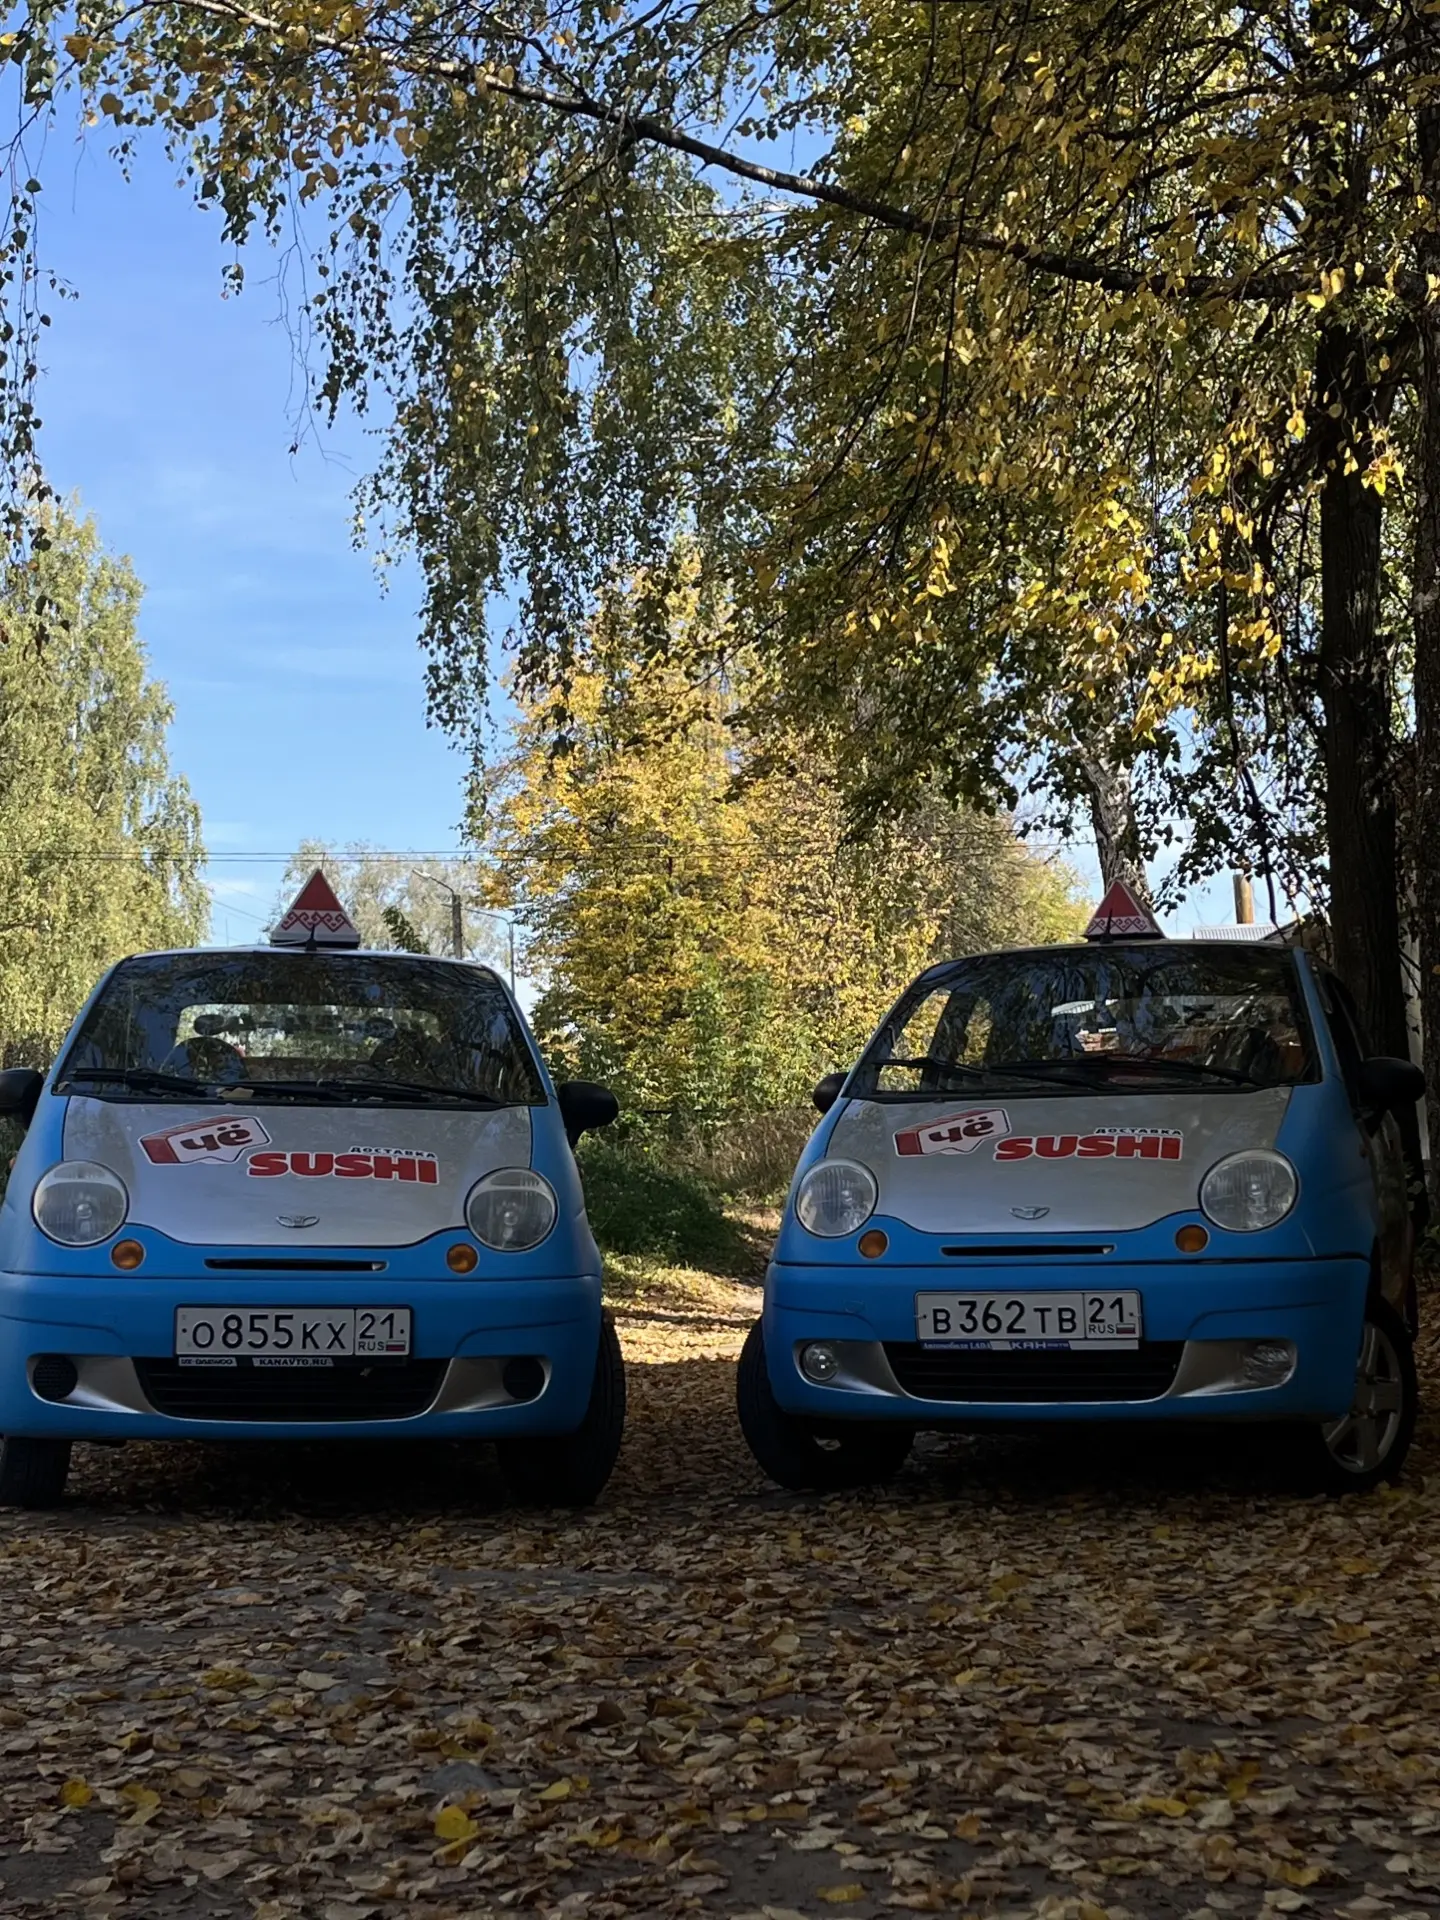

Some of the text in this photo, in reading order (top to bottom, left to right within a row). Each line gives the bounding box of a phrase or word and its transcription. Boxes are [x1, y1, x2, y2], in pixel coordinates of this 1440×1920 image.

[995, 1135, 1182, 1160] SUSHI
[248, 1152, 438, 1183] SUSHI
[1088, 1297, 1125, 1323] 21
[359, 1312, 395, 1340] 21
[1088, 1323, 1115, 1334] RUS
[357, 1340, 384, 1351] RUS
